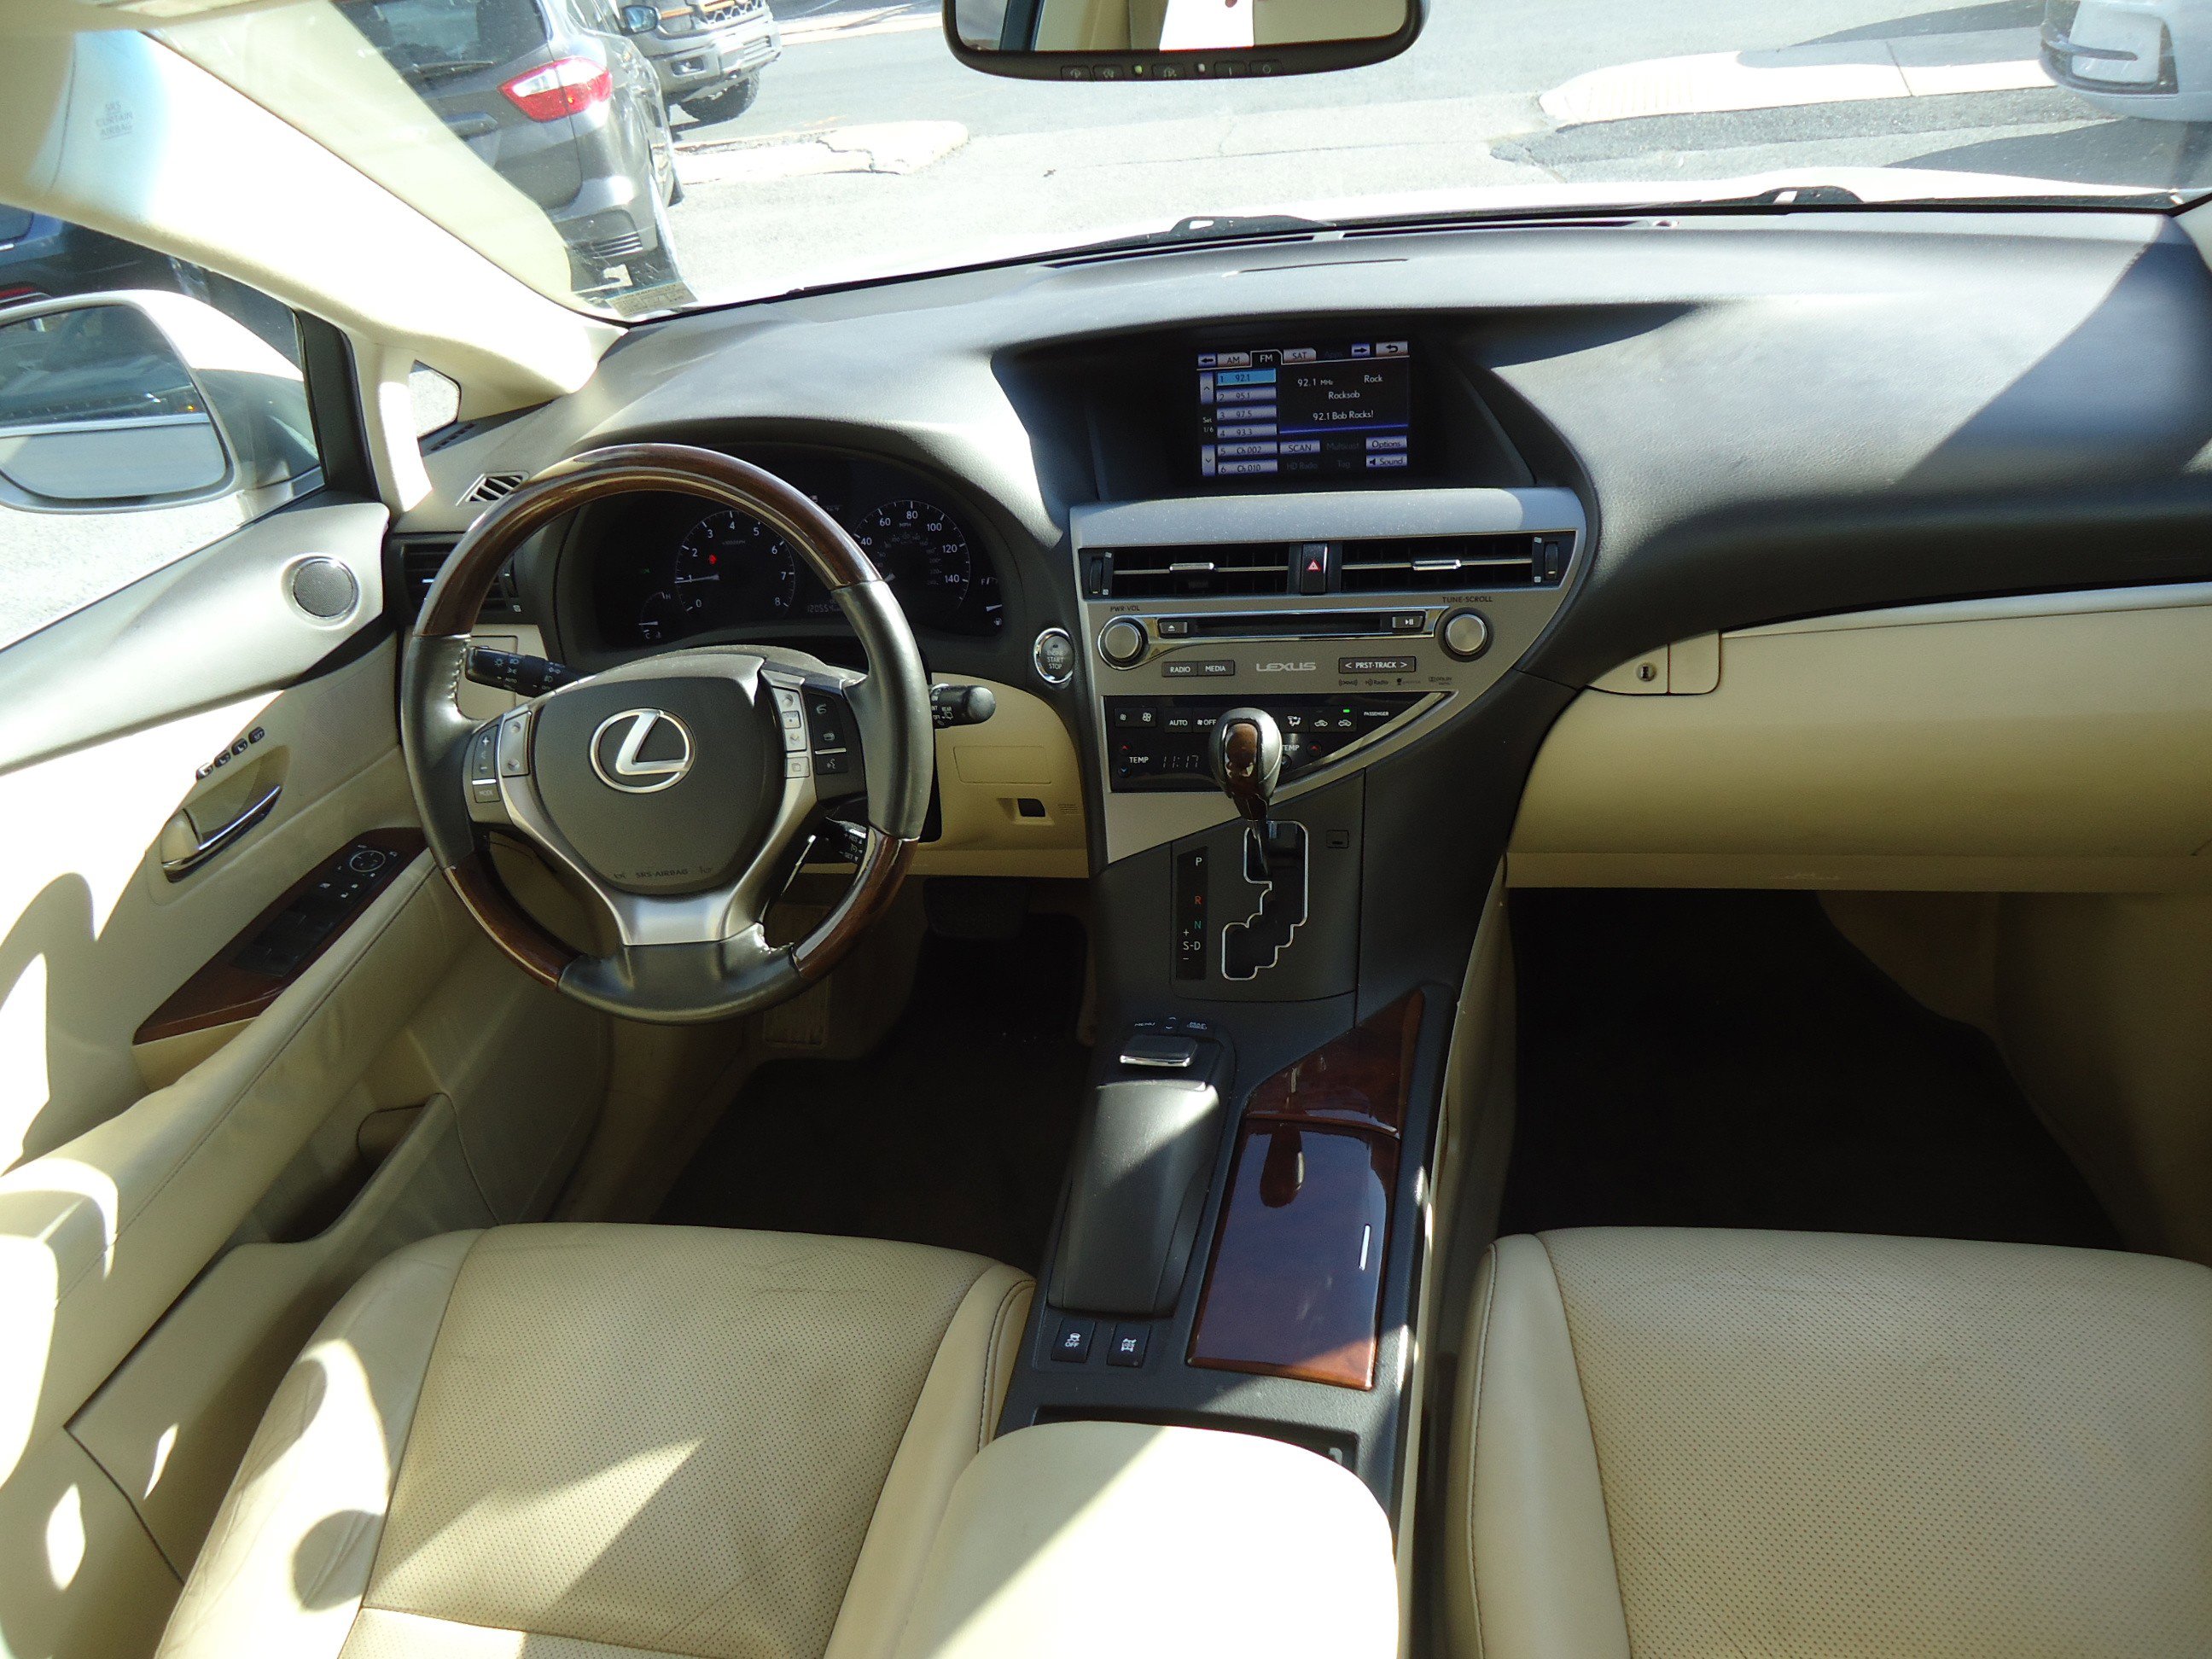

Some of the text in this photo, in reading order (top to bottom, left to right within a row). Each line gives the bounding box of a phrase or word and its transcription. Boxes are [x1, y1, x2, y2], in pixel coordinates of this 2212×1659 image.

[1226, 356, 1240, 364] AM
[1260, 354, 1273, 364] FM
[1236, 374, 1250, 382] 92.1
[1297, 378, 1316, 387] 92.1
[1364, 374, 1383, 384] Rock
[1313, 410, 1375, 422] 92.1 Bob Rocks!
[1288, 444, 1313, 453] SCAN
[1371, 439, 1401, 450] Options
[1379, 457, 1404, 466] Sound
[905, 510, 918, 521] 80
[729, 521, 736, 531] 4
[879, 516, 892, 527] 60
[753, 527, 761, 537] 5
[926, 521, 942, 533] 100
[707, 529, 714, 539] 3
[860, 537, 873, 547] 40
[691, 548, 699, 558] 2
[771, 545, 779, 556] 6
[942, 544, 958, 554] 120
[780, 572, 788, 582] 7
[944, 573, 960, 584] 140
[696, 599, 703, 608] 0
[774, 597, 781, 607] 8
[1169, 665, 1191, 673] RADIO
[1204, 664, 1226, 672] MEDIA
[1255, 661, 1317, 672] LEXUS
[1128, 755, 1150, 765] TEMP
[1162, 754, 1199, 769] 11:17
[1195, 856, 1203, 867] P
[1195, 895, 1202, 905] R
[1194, 919, 1202, 930] N
